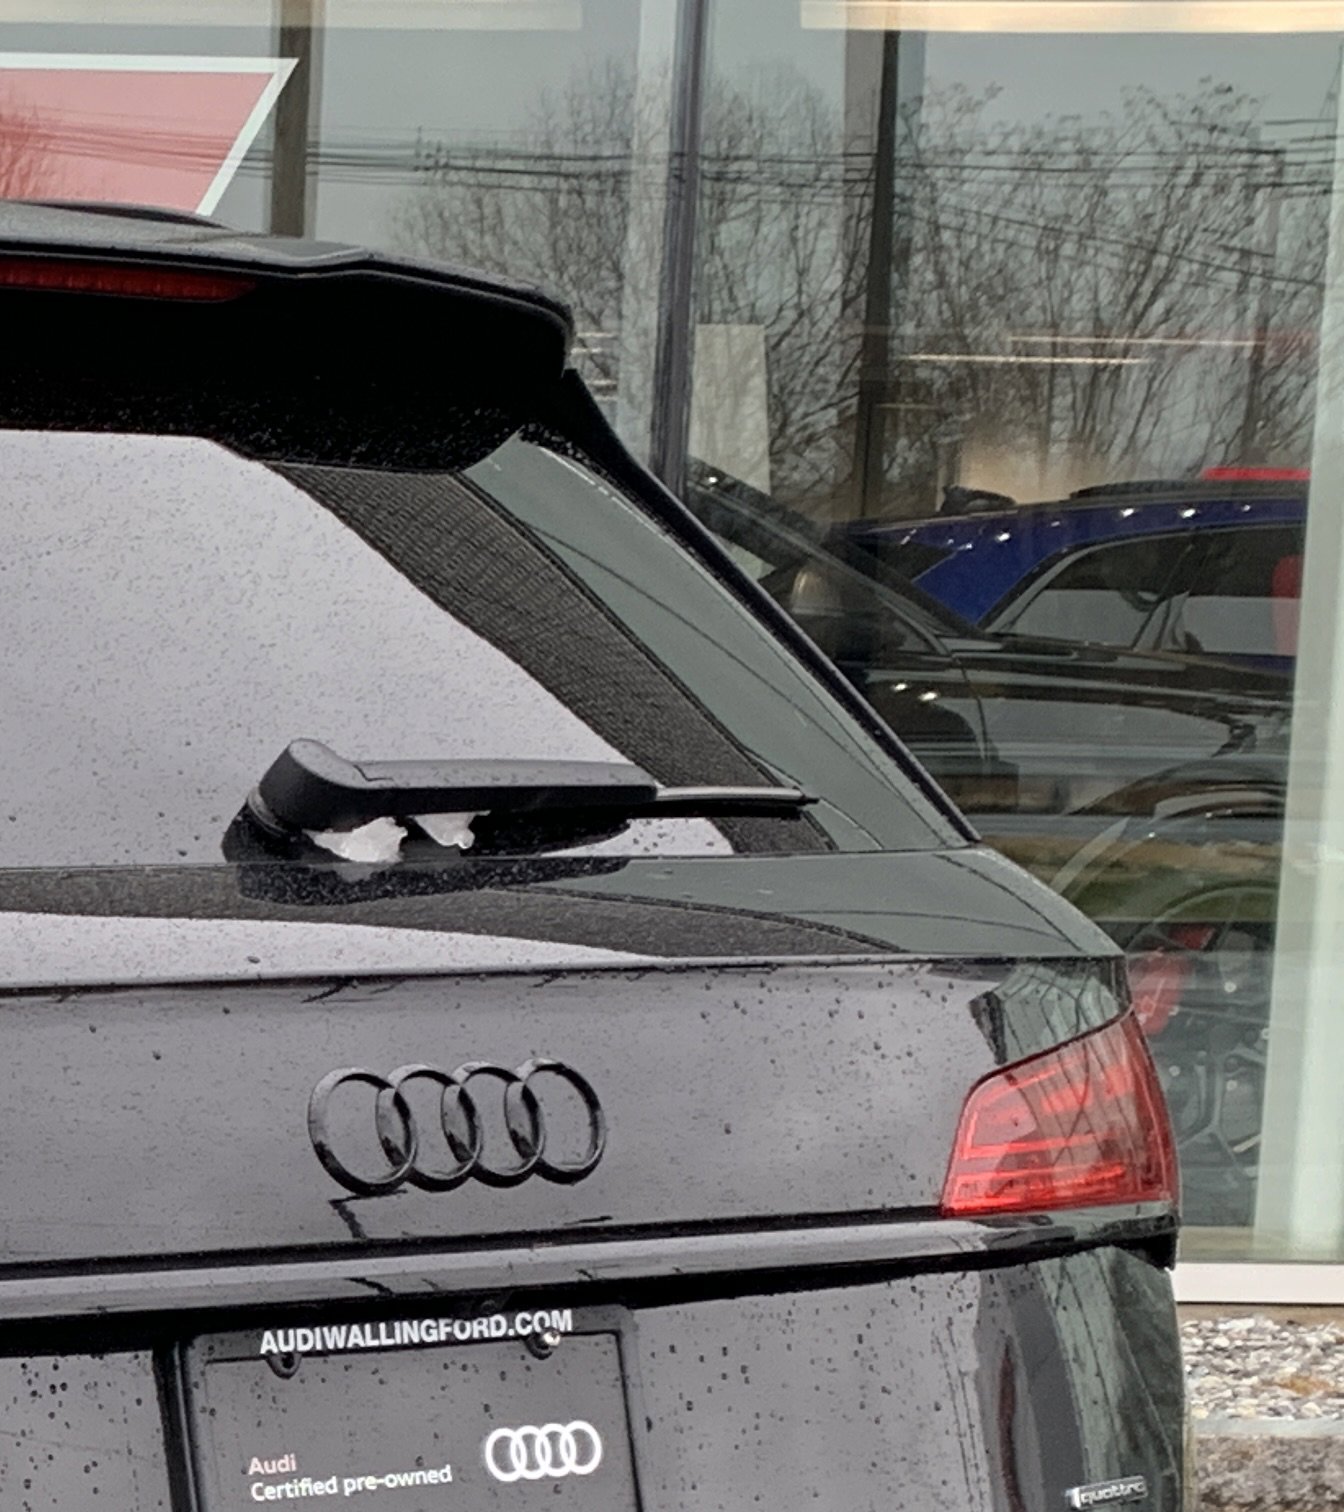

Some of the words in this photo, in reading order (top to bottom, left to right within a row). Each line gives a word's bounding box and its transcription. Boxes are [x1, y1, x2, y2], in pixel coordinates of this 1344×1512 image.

[260, 1309, 573, 1355] AUDIWALLINGFORD.COM
[248, 1453, 297, 1476] Audi
[250, 1476, 339, 1502] Certified
[343, 1464, 453, 1497] pre-owned
[1079, 1481, 1146, 1506] quattro
